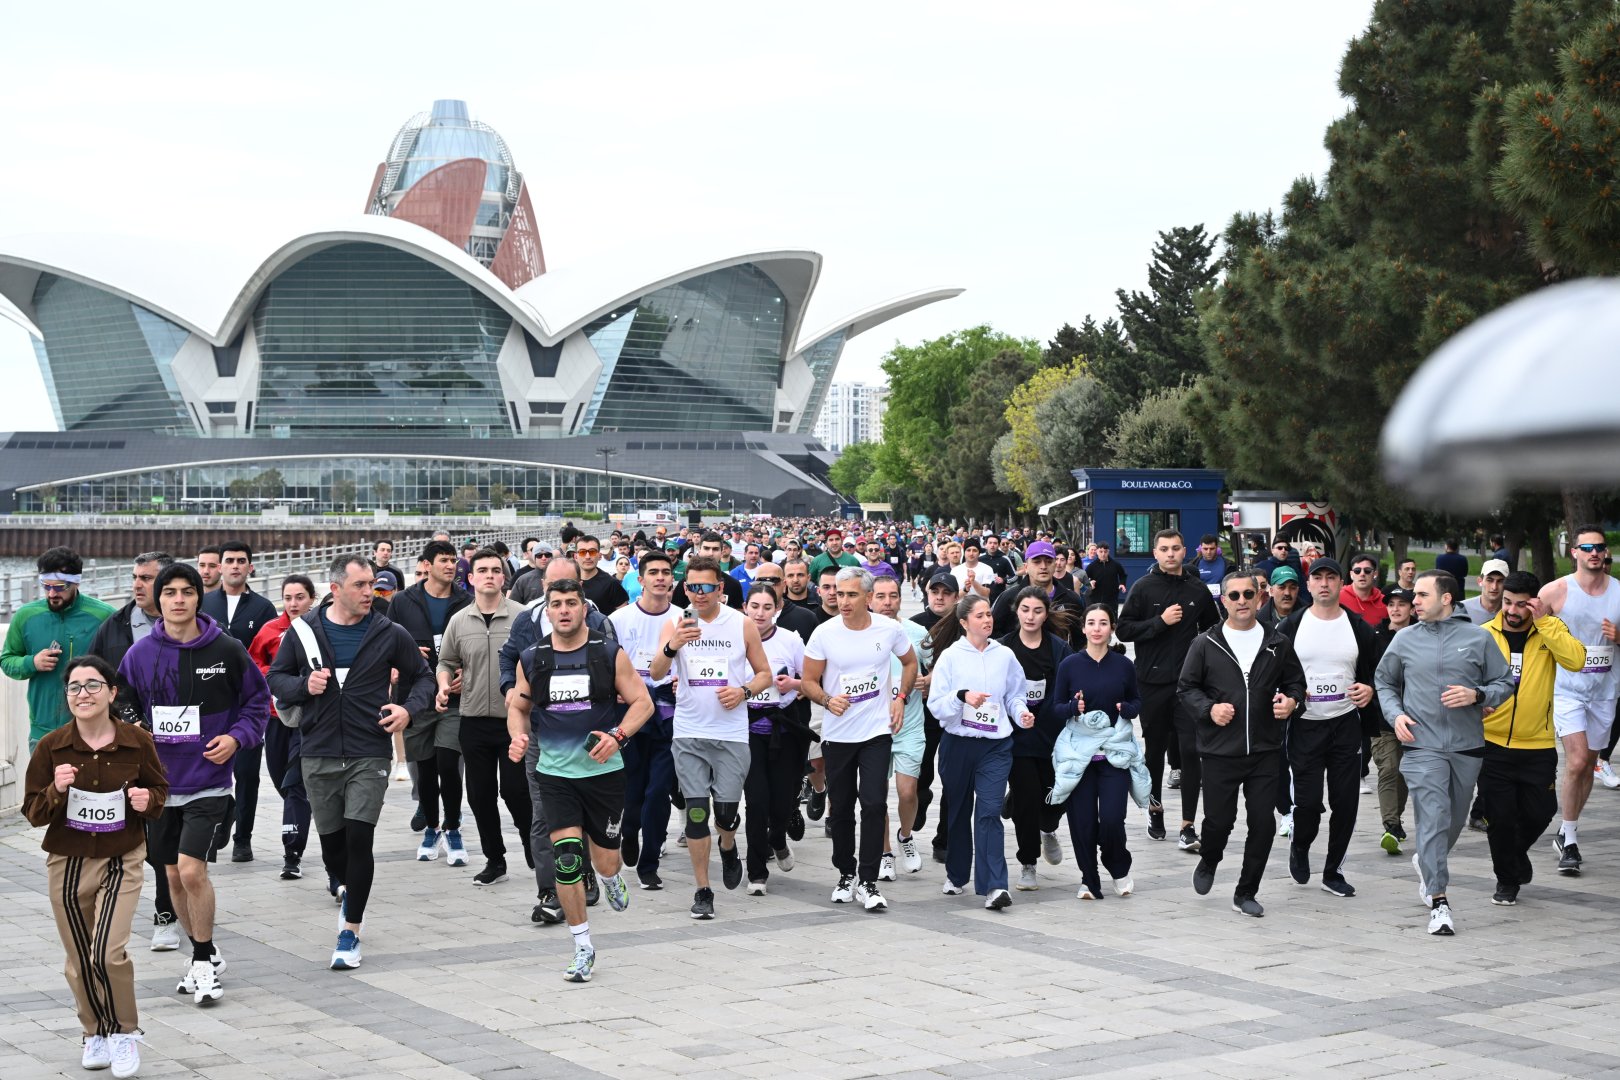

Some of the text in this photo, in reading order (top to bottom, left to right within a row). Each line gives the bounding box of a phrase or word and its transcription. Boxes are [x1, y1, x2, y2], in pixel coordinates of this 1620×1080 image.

[1121, 480, 1192, 488] BOULEVARD&CO.
[687, 640, 732, 648] RUNNING
[1586, 656, 1609, 665] 5075
[700, 668, 714, 677] 49
[845, 681, 876, 695] 24976
[1316, 684, 1337, 694] 590
[550, 690, 579, 701] 3732
[975, 712, 989, 722] 95
[159, 721, 190, 733] 4067
[77, 807, 116, 820] 4105
